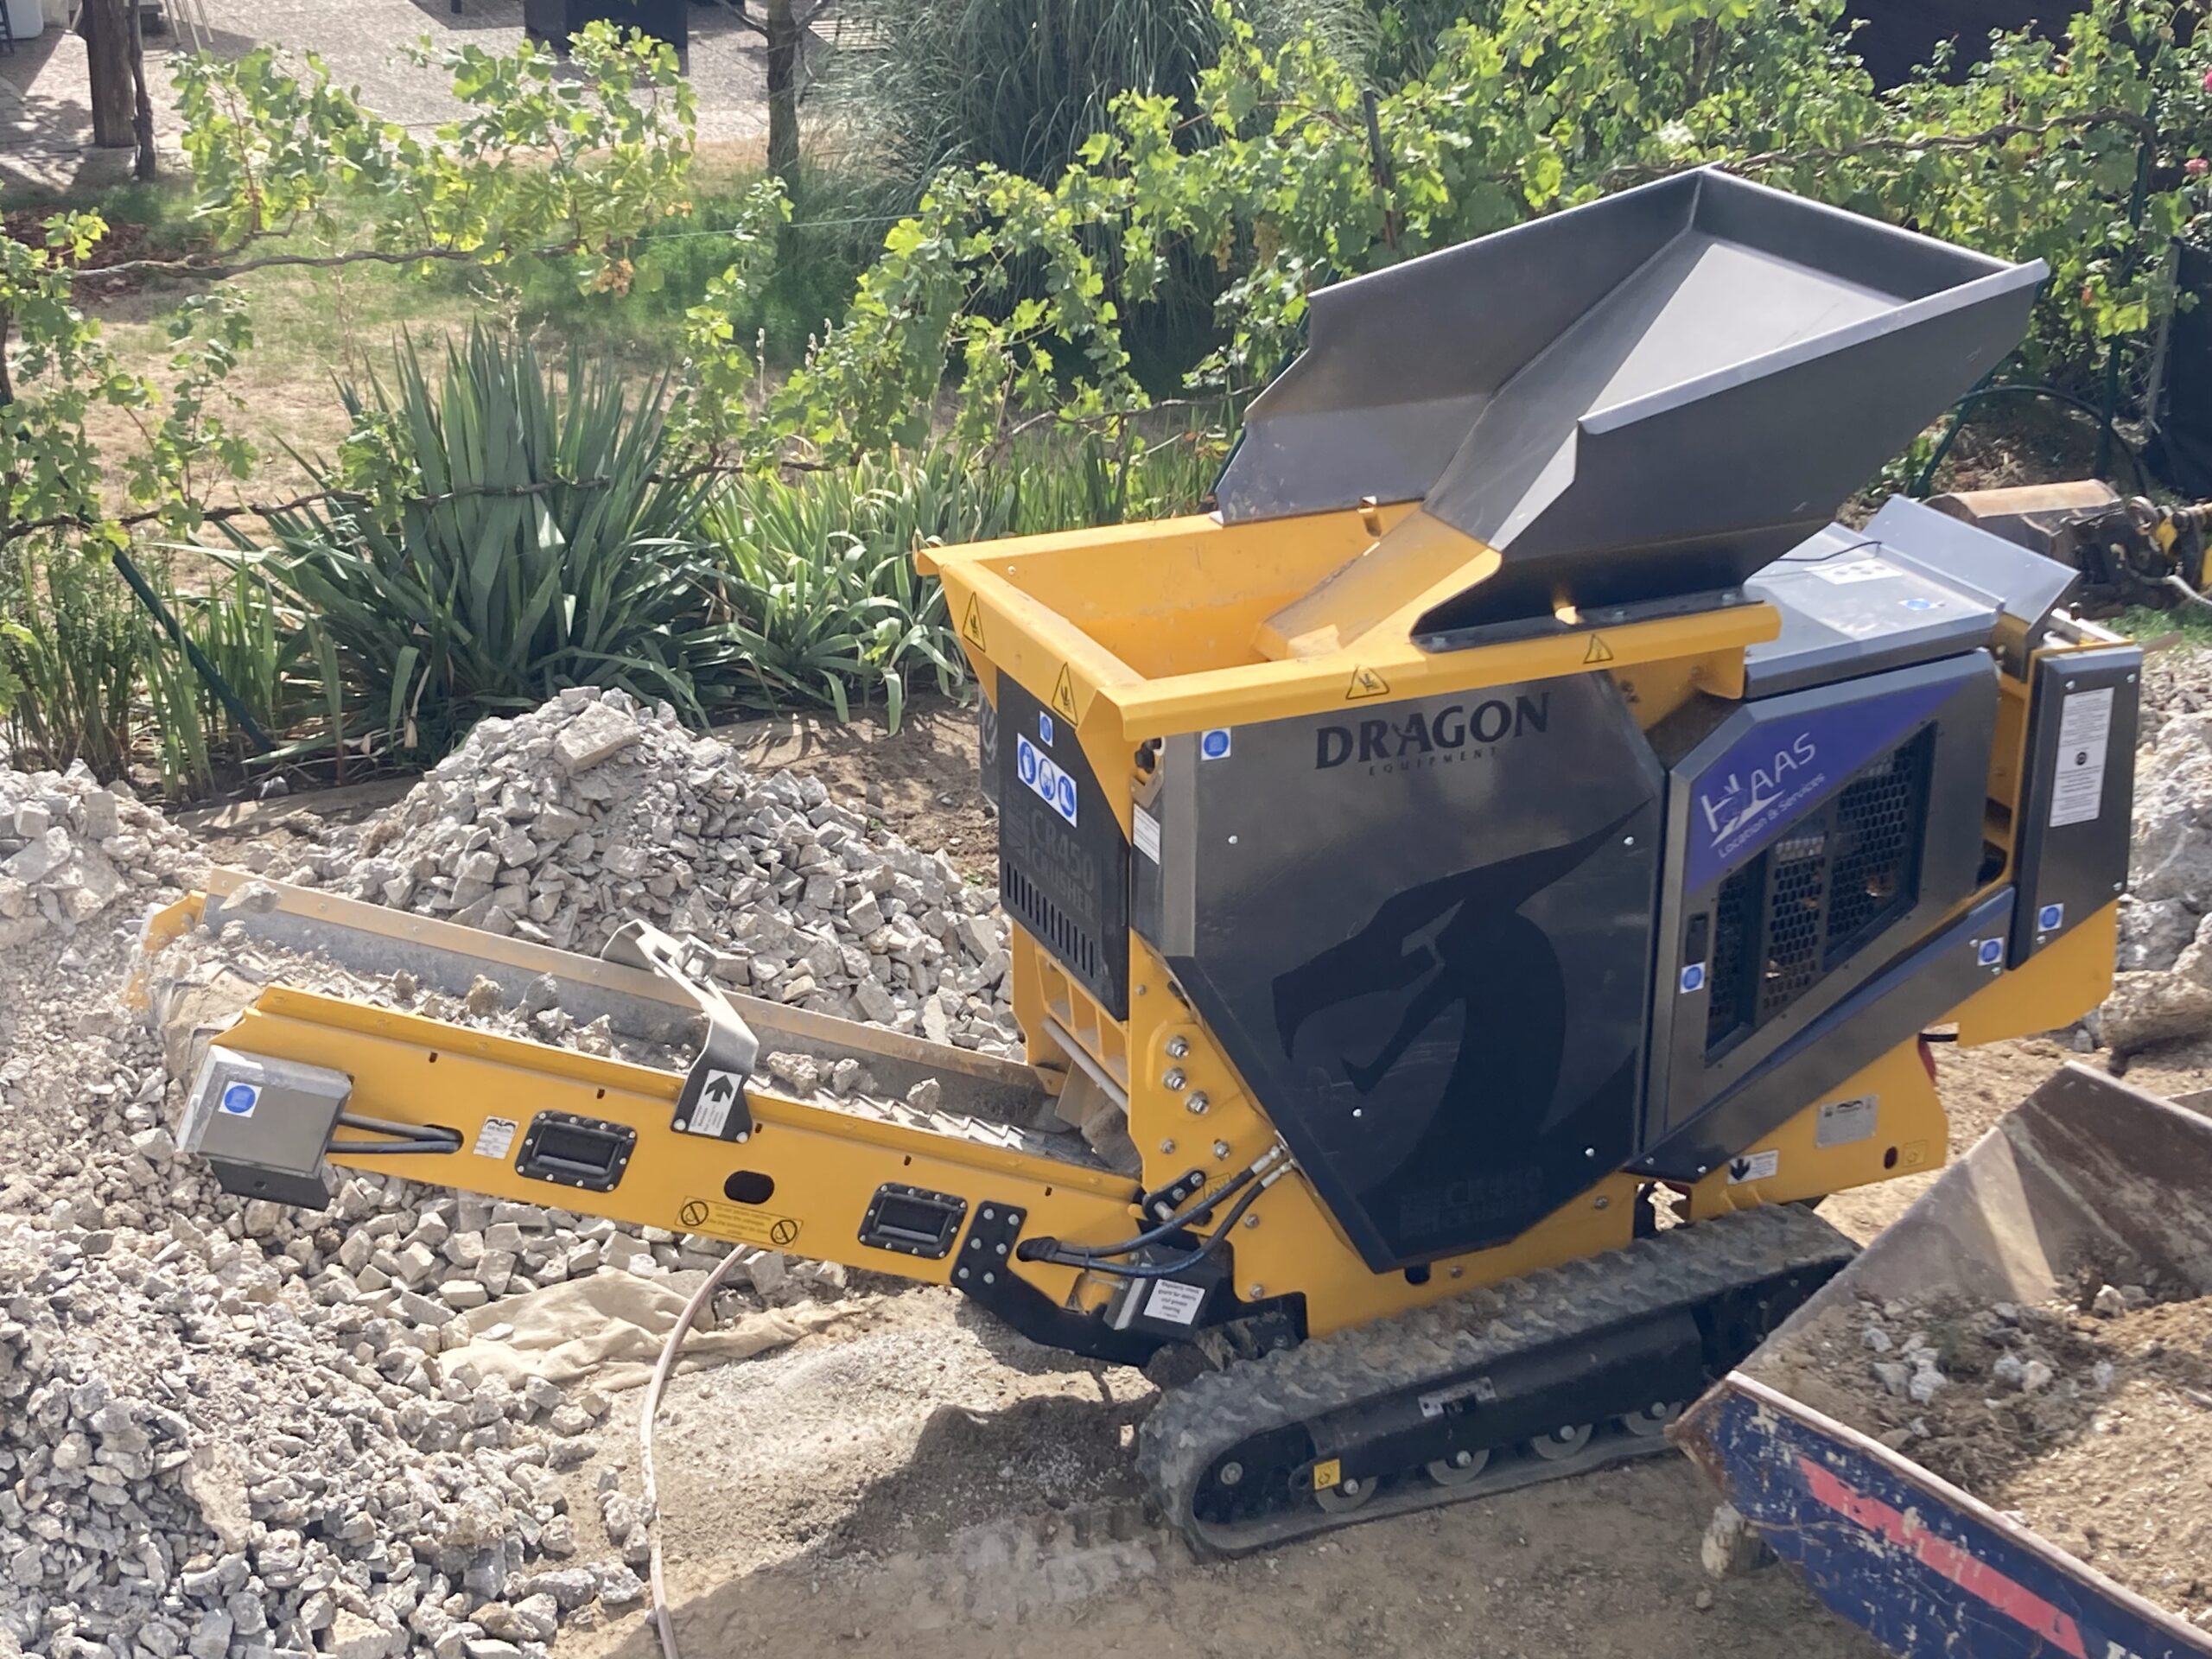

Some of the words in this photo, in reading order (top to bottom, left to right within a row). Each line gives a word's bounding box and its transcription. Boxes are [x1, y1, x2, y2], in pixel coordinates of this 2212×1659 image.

[1315, 692, 1549, 769] DRAGON
[1369, 747, 1497, 776] EQUIPMENT
[1700, 733, 1816, 833] HAAS
[1718, 817, 1768, 858] Location
[1768, 809, 1779, 821] &
[1777, 772, 1826, 811] Services
[1031, 808, 1095, 891] CR450
